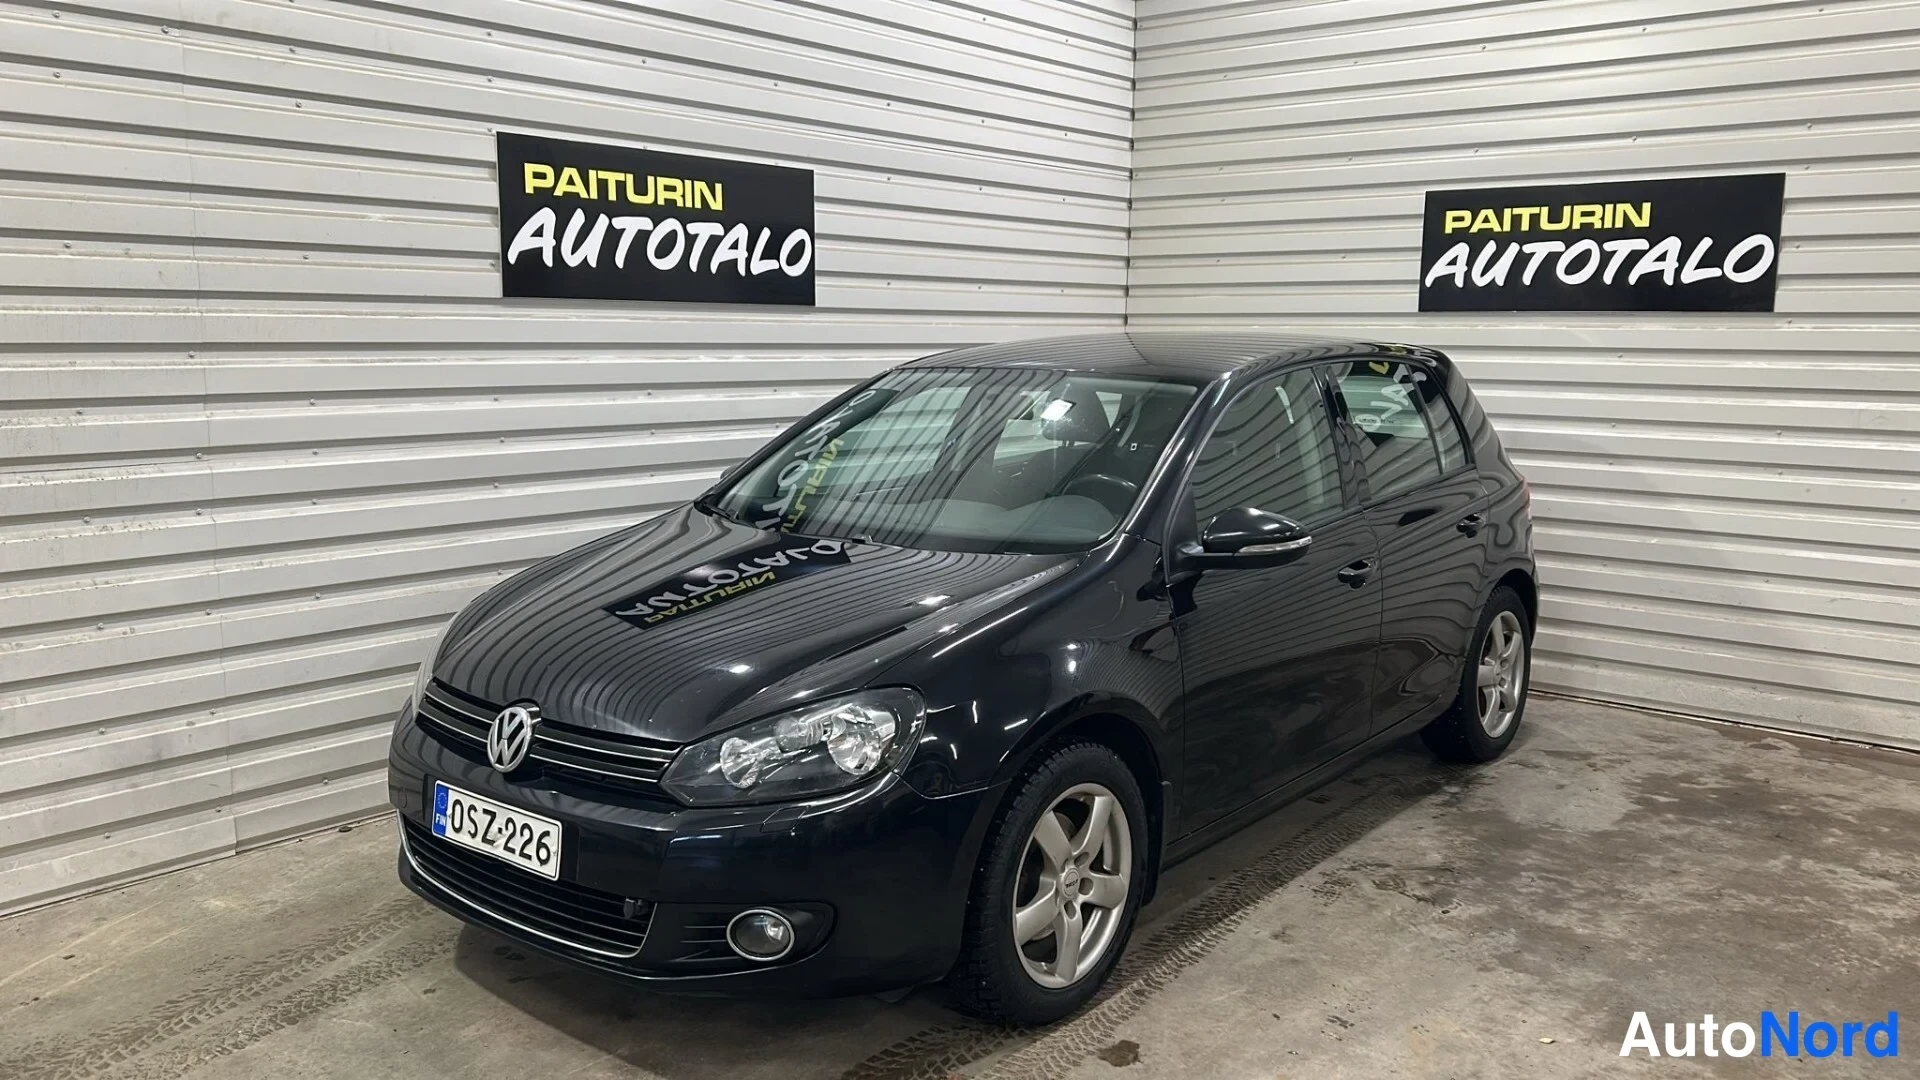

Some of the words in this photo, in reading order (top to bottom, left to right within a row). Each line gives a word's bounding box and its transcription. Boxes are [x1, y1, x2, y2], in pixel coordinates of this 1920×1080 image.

[524, 162, 723, 211] PAITURIN
[507, 207, 812, 278] AUTOTALO
[1444, 202, 1652, 234] PAITURIN
[1424, 234, 1775, 288] AUTOTALO
[435, 812, 447, 827] FIN
[451, 799, 551, 867] OSZ-226
